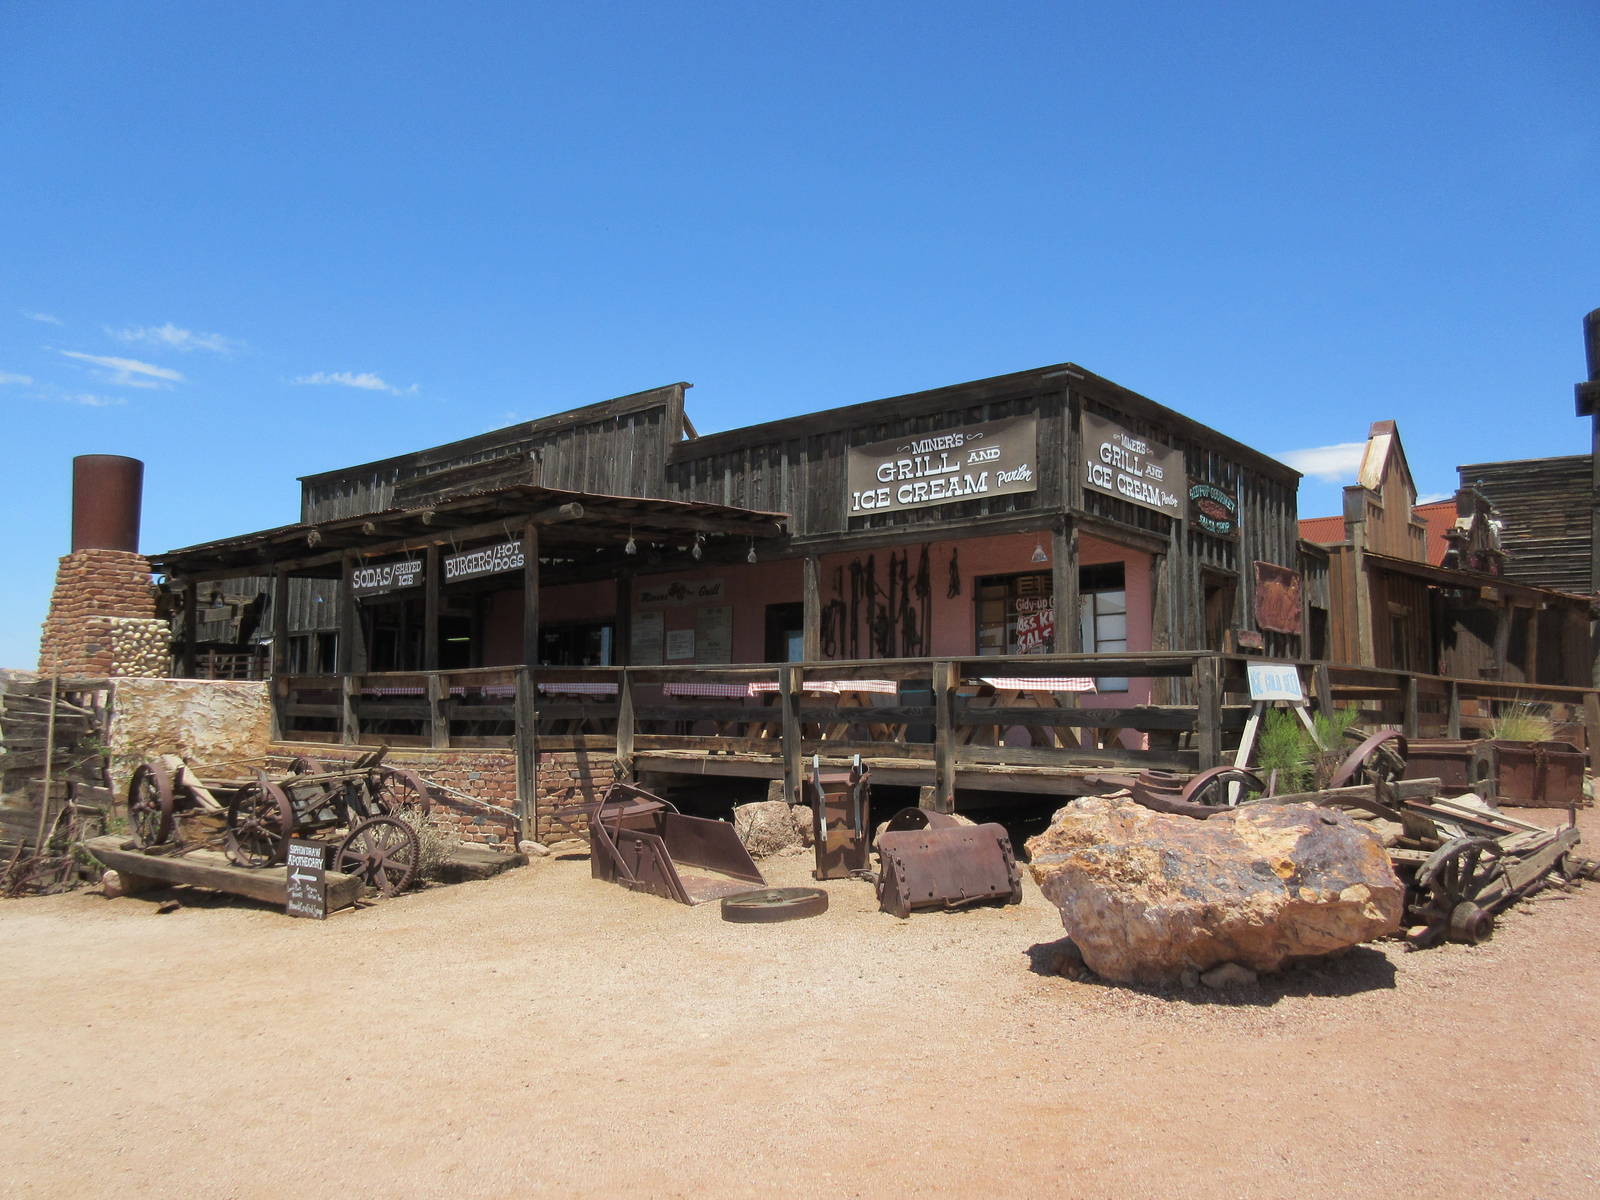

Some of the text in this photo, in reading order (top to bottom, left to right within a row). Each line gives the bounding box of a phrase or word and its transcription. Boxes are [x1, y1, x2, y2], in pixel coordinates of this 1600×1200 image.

[911, 433, 964, 455] MINER'S
[876, 448, 1001, 483] GRILL AND
[1100, 442, 1163, 479] GRILL AND
[852, 463, 1032, 511] ICE CREAM Parlor
[1087, 460, 1113, 490] ICE
[1117, 473, 1161, 507] CREAM
[497, 542, 521, 557] HOT
[395, 560, 421, 575] SHAVED
[495, 554, 525, 572] DOGS
[398, 575, 414, 586] ICE
